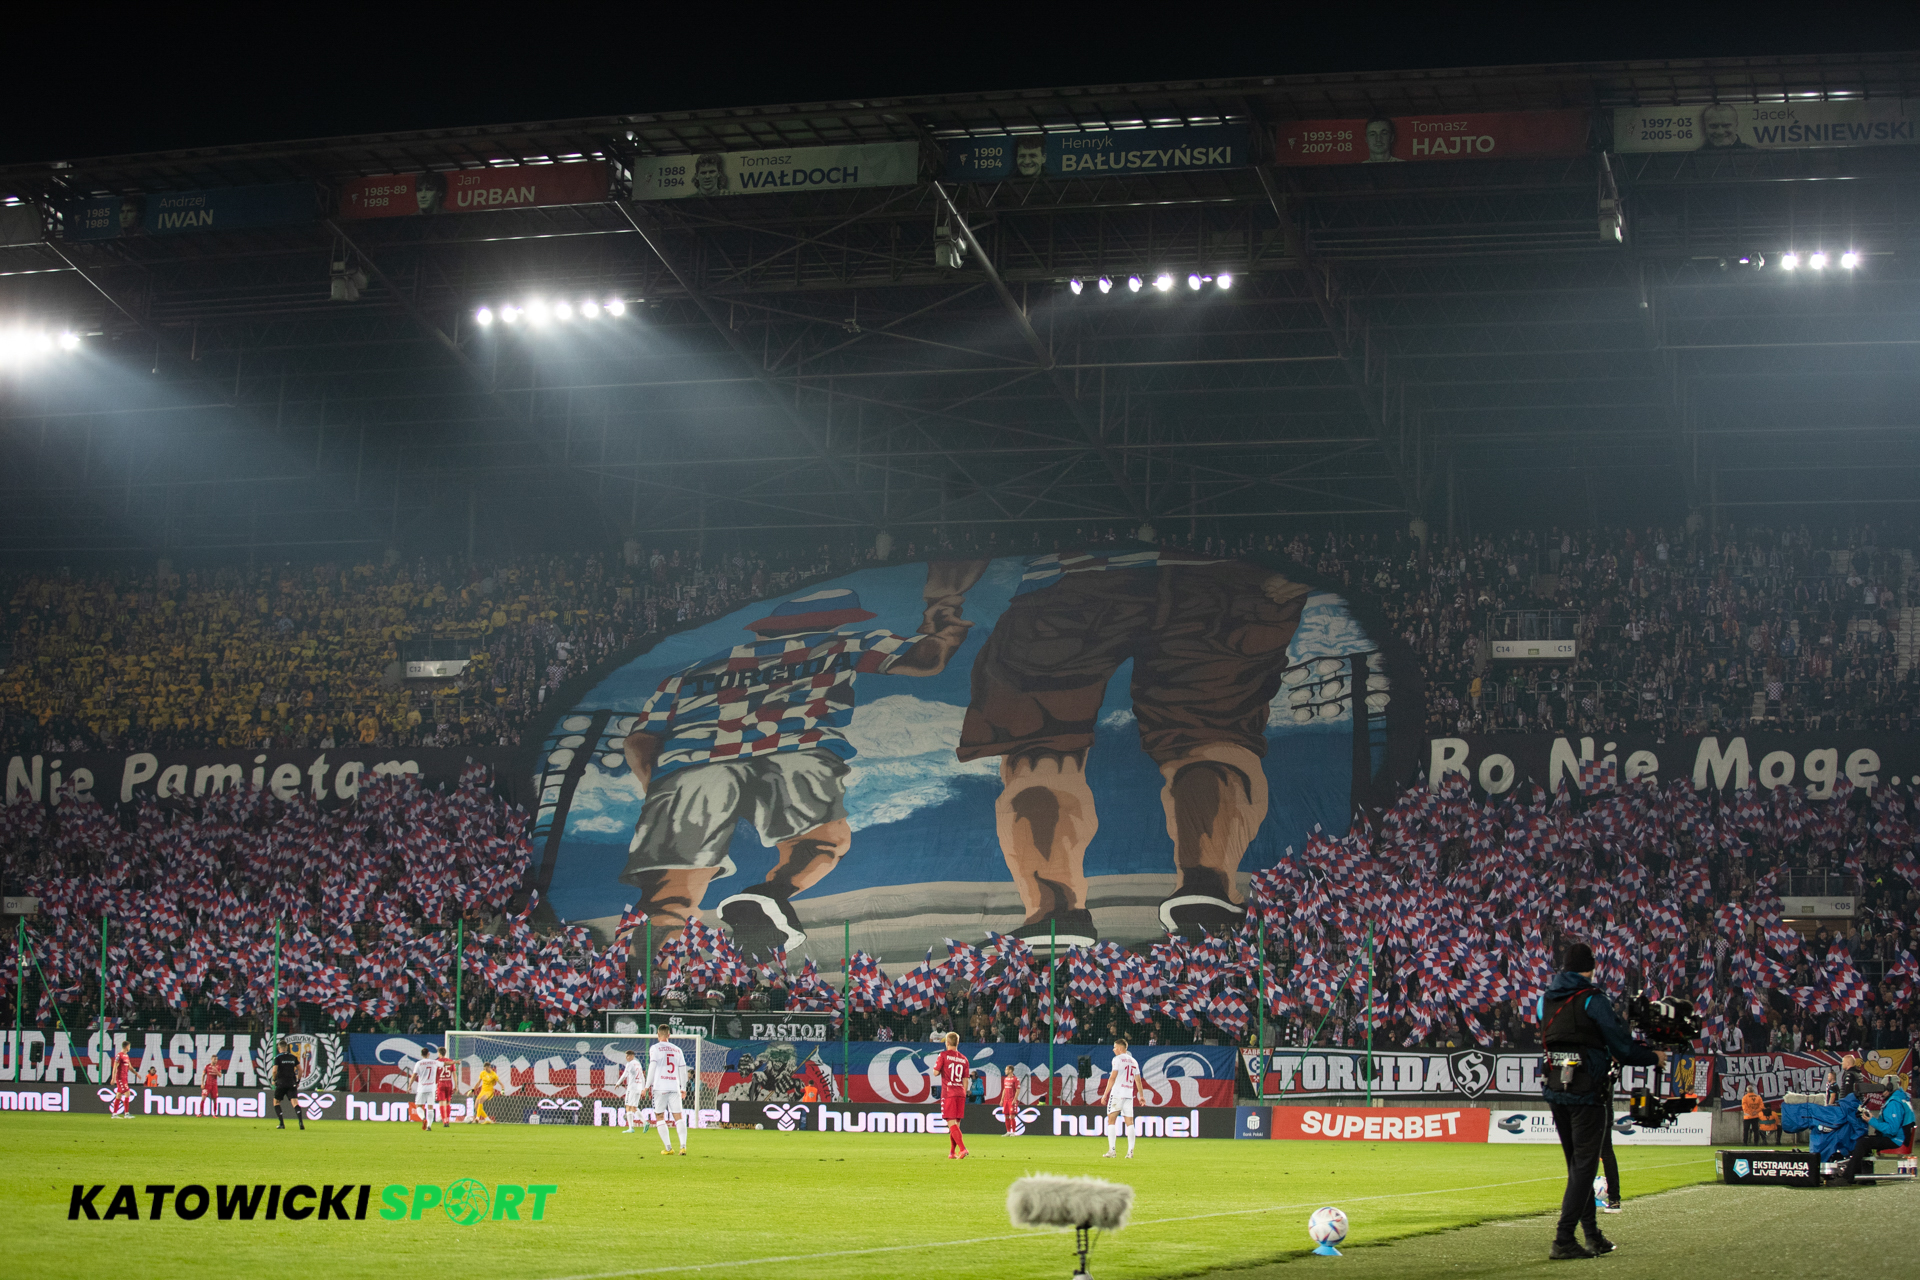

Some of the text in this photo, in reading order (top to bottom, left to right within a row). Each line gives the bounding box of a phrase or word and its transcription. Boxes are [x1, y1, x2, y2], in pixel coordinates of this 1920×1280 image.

[1752, 107, 1795, 121] Jacek
[1411, 120, 1468, 132] Tomasz
[1641, 117, 1693, 129] 1997-03
[1302, 130, 1353, 141] 1993-96
[1640, 129, 1693, 140] 2005-06
[1752, 120, 1915, 144] WIŚNIEWSKI
[1062, 135, 1113, 150] Henryk
[1301, 142, 1353, 153] 2007-08
[1411, 135, 1495, 155] HAJTO
[974, 147, 1003, 158] 1990
[1061, 143, 1232, 172] BAŁUSZYŃSKI
[740, 155, 792, 167] Tomasz
[973, 159, 1003, 169] 1994
[658, 166, 686, 176] 1988
[739, 166, 859, 189] WAŁDOCH
[457, 175, 481, 186] Jan
[657, 178, 685, 188] 1994
[364, 184, 407, 197] 1985-89
[456, 185, 536, 207] URBAN
[159, 194, 207, 209] Andrzej
[363, 197, 389, 208] 1998
[86, 207, 111, 218] 1985
[157, 209, 214, 229] IWAN
[85, 218, 110, 229] 1989
[683, 652, 854, 696] TORCIDA
[1429, 737, 1515, 794] Bo
[1549, 736, 1659, 794] Nie
[5, 754, 94, 807] Nie
[1835, 902, 1851, 910] C05
[649, 1023, 708, 1039] DWID
[751, 1023, 827, 1038] PASTOR
[666, 1053, 675, 1073] 5
[1725, 1055, 1785, 1074] EKIPA
[426, 1066, 432, 1080] 7
[439, 1065, 451, 1078] 25
[948, 1062, 964, 1083] 19
[1124, 1065, 1136, 1084] 15
[1272, 1055, 1454, 1092] TORCIDA
[1721, 1065, 1845, 1101] SZYDERCZY
[144, 1088, 267, 1119] hummel
[818, 1104, 950, 1134] humme
[1301, 1111, 1462, 1140] SUPERBET
[1531, 1116, 1556, 1126] OLT
[1752, 1160, 1809, 1170] EKSTRAKLASA
[1752, 1169, 1777, 1177] LIVE
